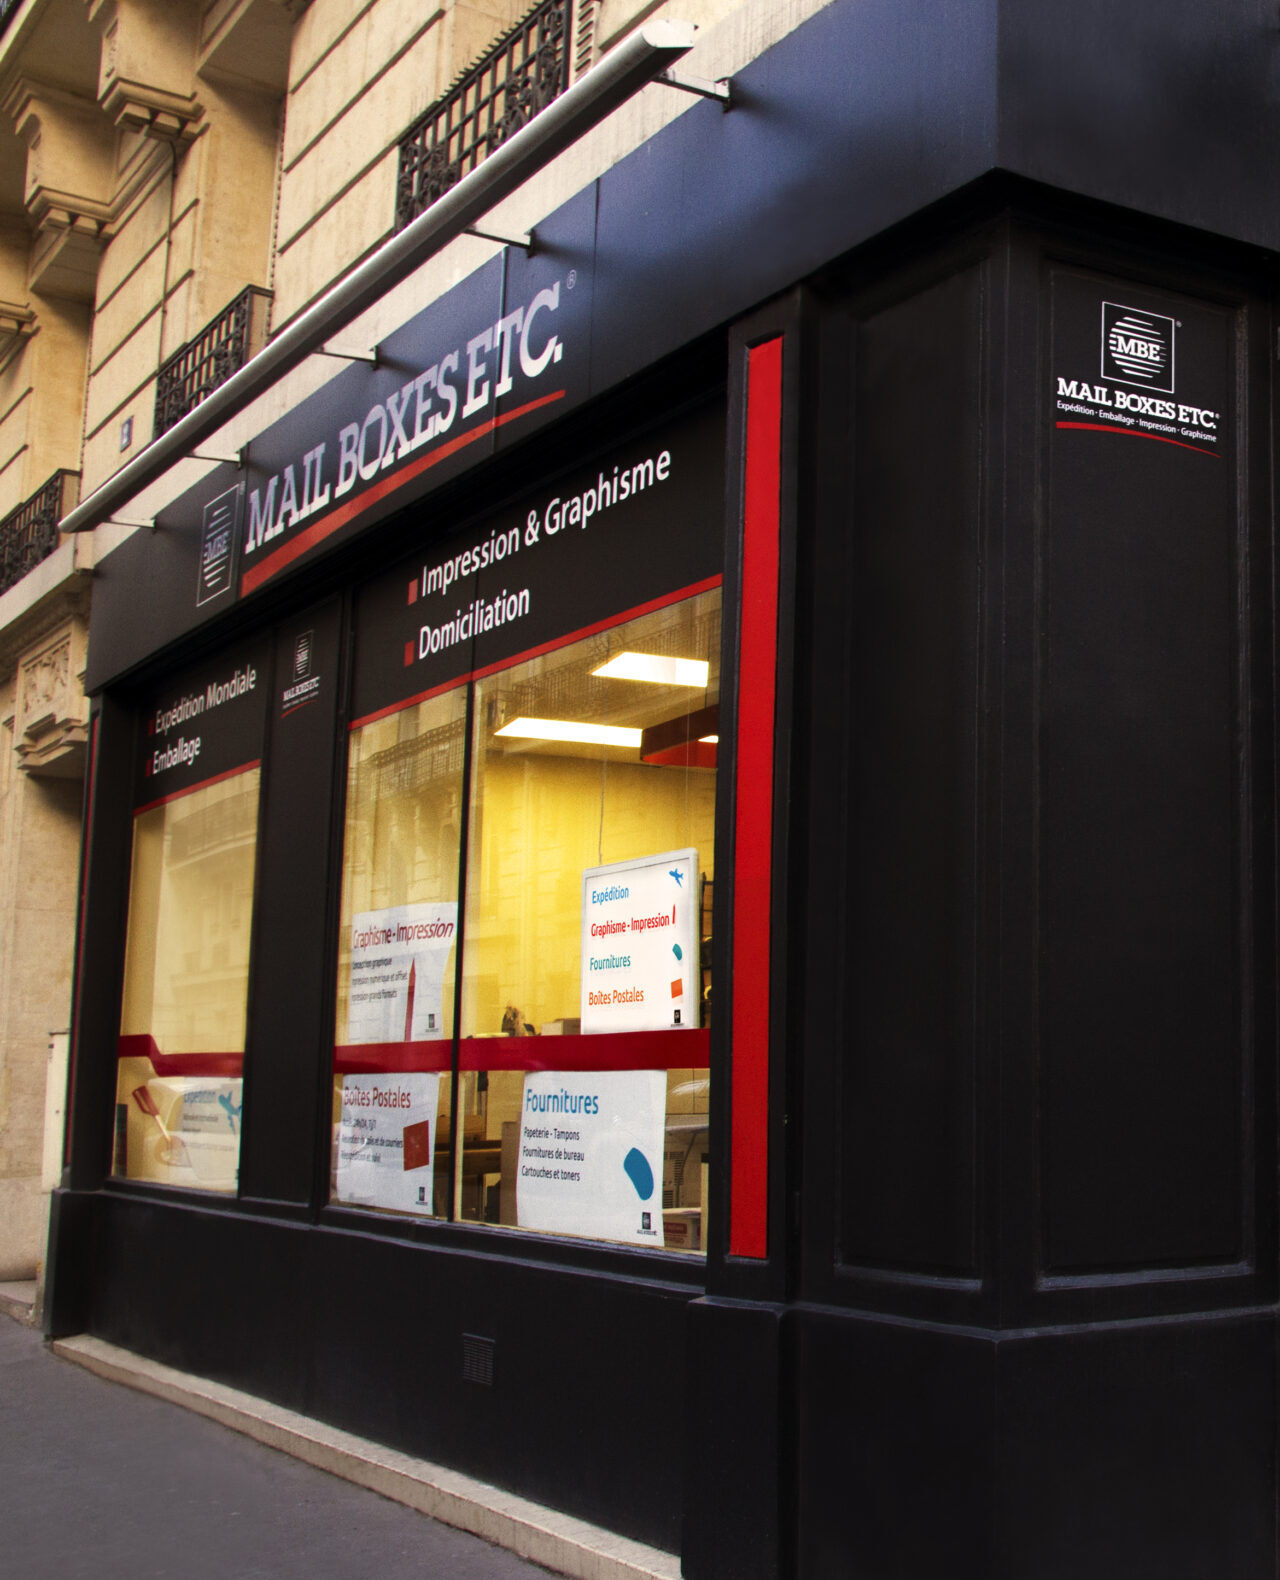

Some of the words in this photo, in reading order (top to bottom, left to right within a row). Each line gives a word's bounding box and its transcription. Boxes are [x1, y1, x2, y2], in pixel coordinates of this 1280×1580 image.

[1116, 335, 1161, 361] MBE
[1057, 377, 1113, 407] MAIL
[1114, 390, 1176, 420] BOXES
[1178, 404, 1217, 429] ETC.
[245, 443, 331, 554] MAIL
[335, 350, 459, 498] BOXES
[462, 281, 564, 419] ETC.
[1057, 400, 1095, 416] Expédition
[1098, 410, 1136, 426] Emballage
[1139, 418, 1177, 434] Impression
[1180, 427, 1217, 443] Graphisme
[422, 527, 520, 597] Impression
[524, 510, 541, 547] &
[545, 450, 671, 535] Graphisme
[419, 588, 530, 660] Domiciliation
[155, 694, 204, 735] Expédition
[206, 664, 257, 711] Mondiale
[153, 736, 201, 774] Emballage
[592, 886, 629, 905] Expédition
[353, 923, 391, 951] Graphisme
[397, 917, 454, 945] Impression
[591, 920, 626, 939] Graphisme
[631, 912, 669, 933] Impression
[590, 954, 631, 971] Fournitures
[589, 990, 611, 1006] Boîtes
[613, 986, 644, 1004] Postales
[372, 1086, 411, 1108] Postales
[526, 1088, 599, 1115] Fournitures
[524, 1126, 550, 1139] Papeterie
[553, 1128, 580, 1141] Tampons
[522, 1146, 554, 1160] Fournitures
[555, 1148, 562, 1160] de
[564, 1149, 584, 1162] bureau
[521, 1165, 553, 1180] Cartouches
[553, 1167, 560, 1180] et
[560, 1168, 581, 1182] toners
